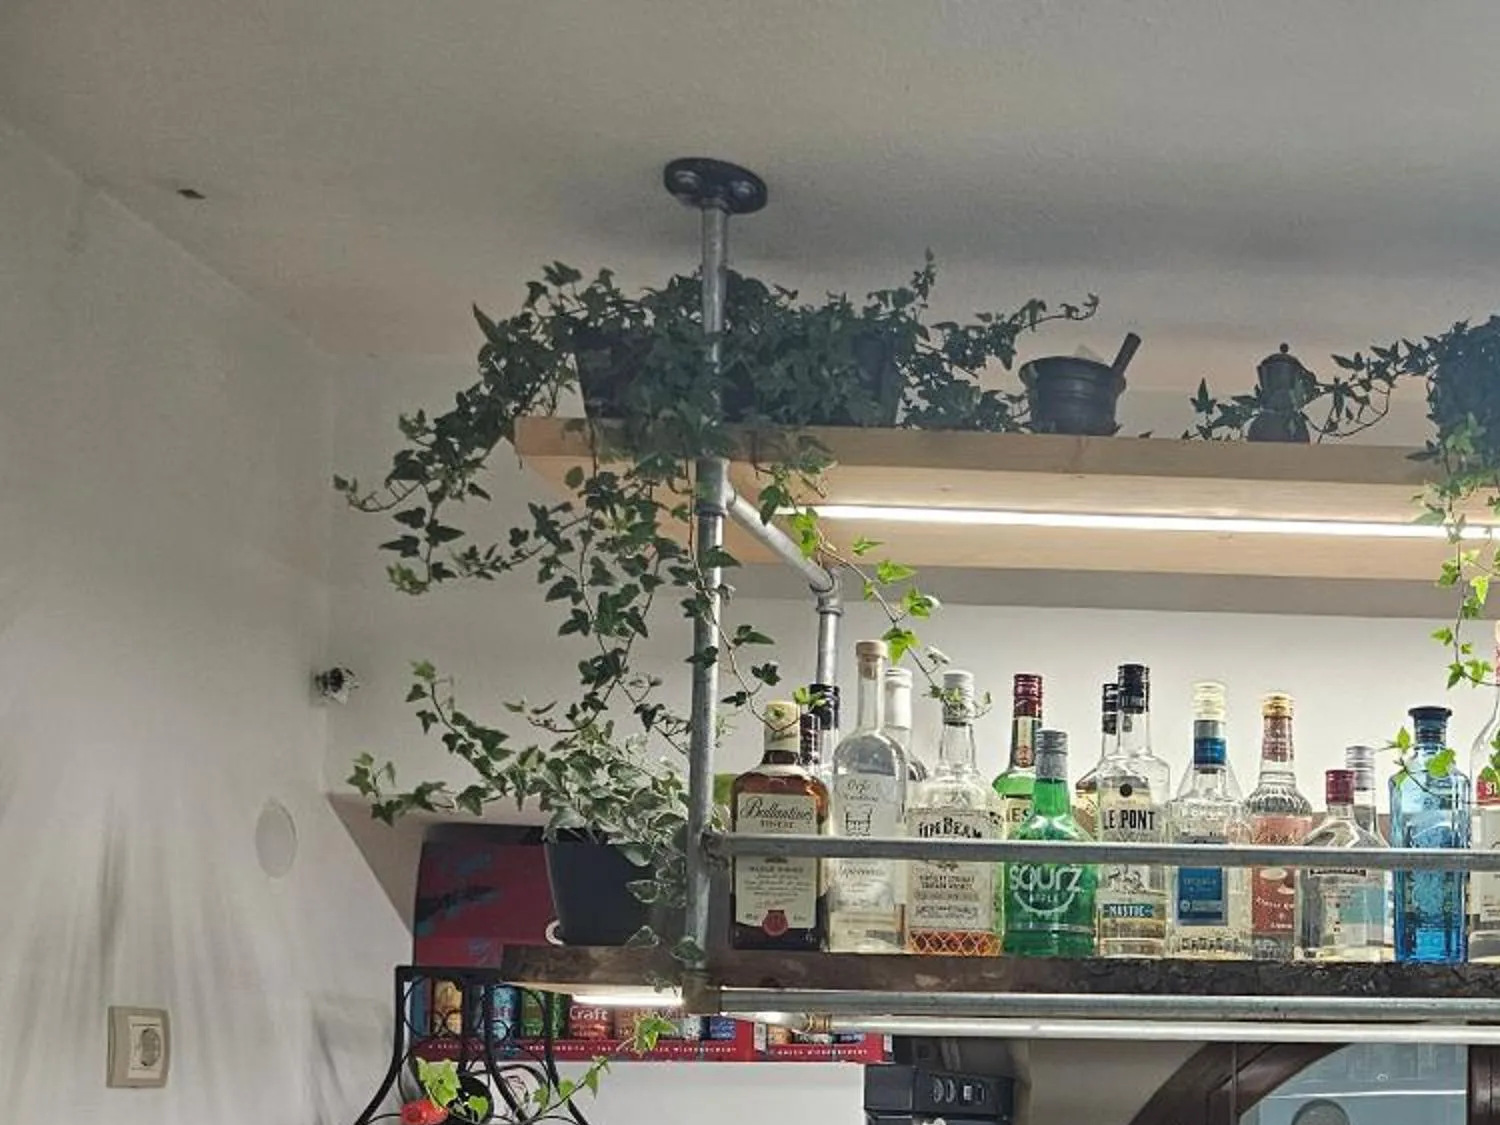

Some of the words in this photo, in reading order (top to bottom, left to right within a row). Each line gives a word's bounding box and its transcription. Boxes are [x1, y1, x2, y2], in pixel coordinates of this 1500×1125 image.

[1103, 811, 1117, 831] LE
[1120, 810, 1156, 831] PONT
[1008, 864, 1085, 892] sourz
[568, 1004, 609, 1022] Craft
